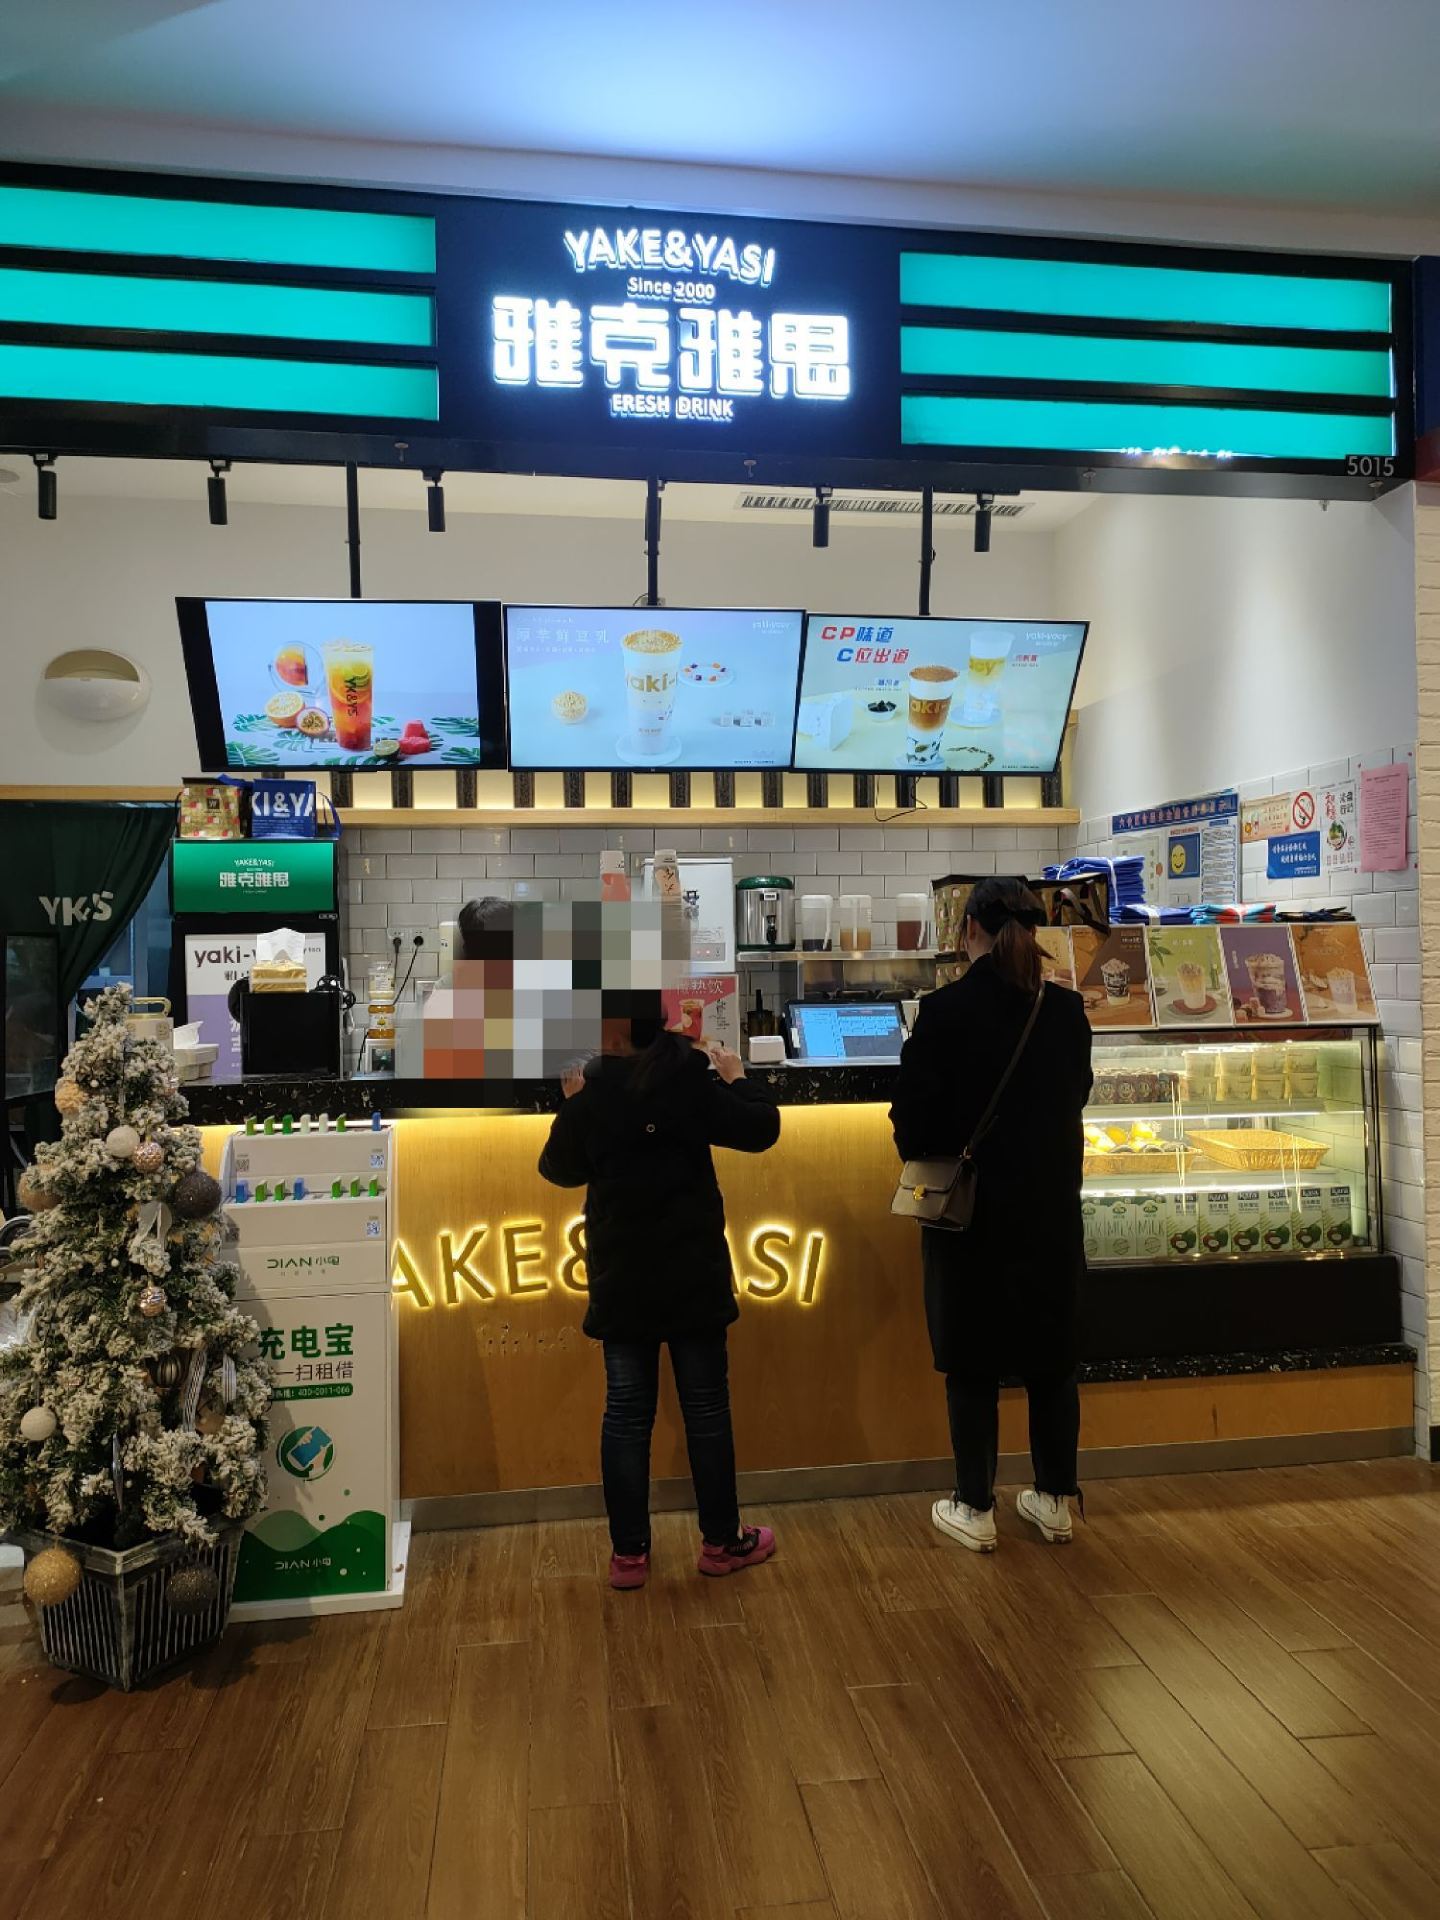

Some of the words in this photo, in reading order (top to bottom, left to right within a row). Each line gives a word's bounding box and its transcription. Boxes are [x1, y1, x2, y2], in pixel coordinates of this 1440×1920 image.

[564, 227, 775, 286] YAKE&YASI
[627, 276, 672, 298] Since
[673, 281, 717, 302] 2000
[493, 296, 851, 399] 雅克雅思
[611, 393, 670, 418] FRESH
[676, 395, 734, 420] DRINK
[1347, 455, 1394, 477] 5015
[821, 626, 895, 643] CP味道
[219, 872, 289, 888] 雅克雅思
[259, 1323, 354, 1360] 充电宝
